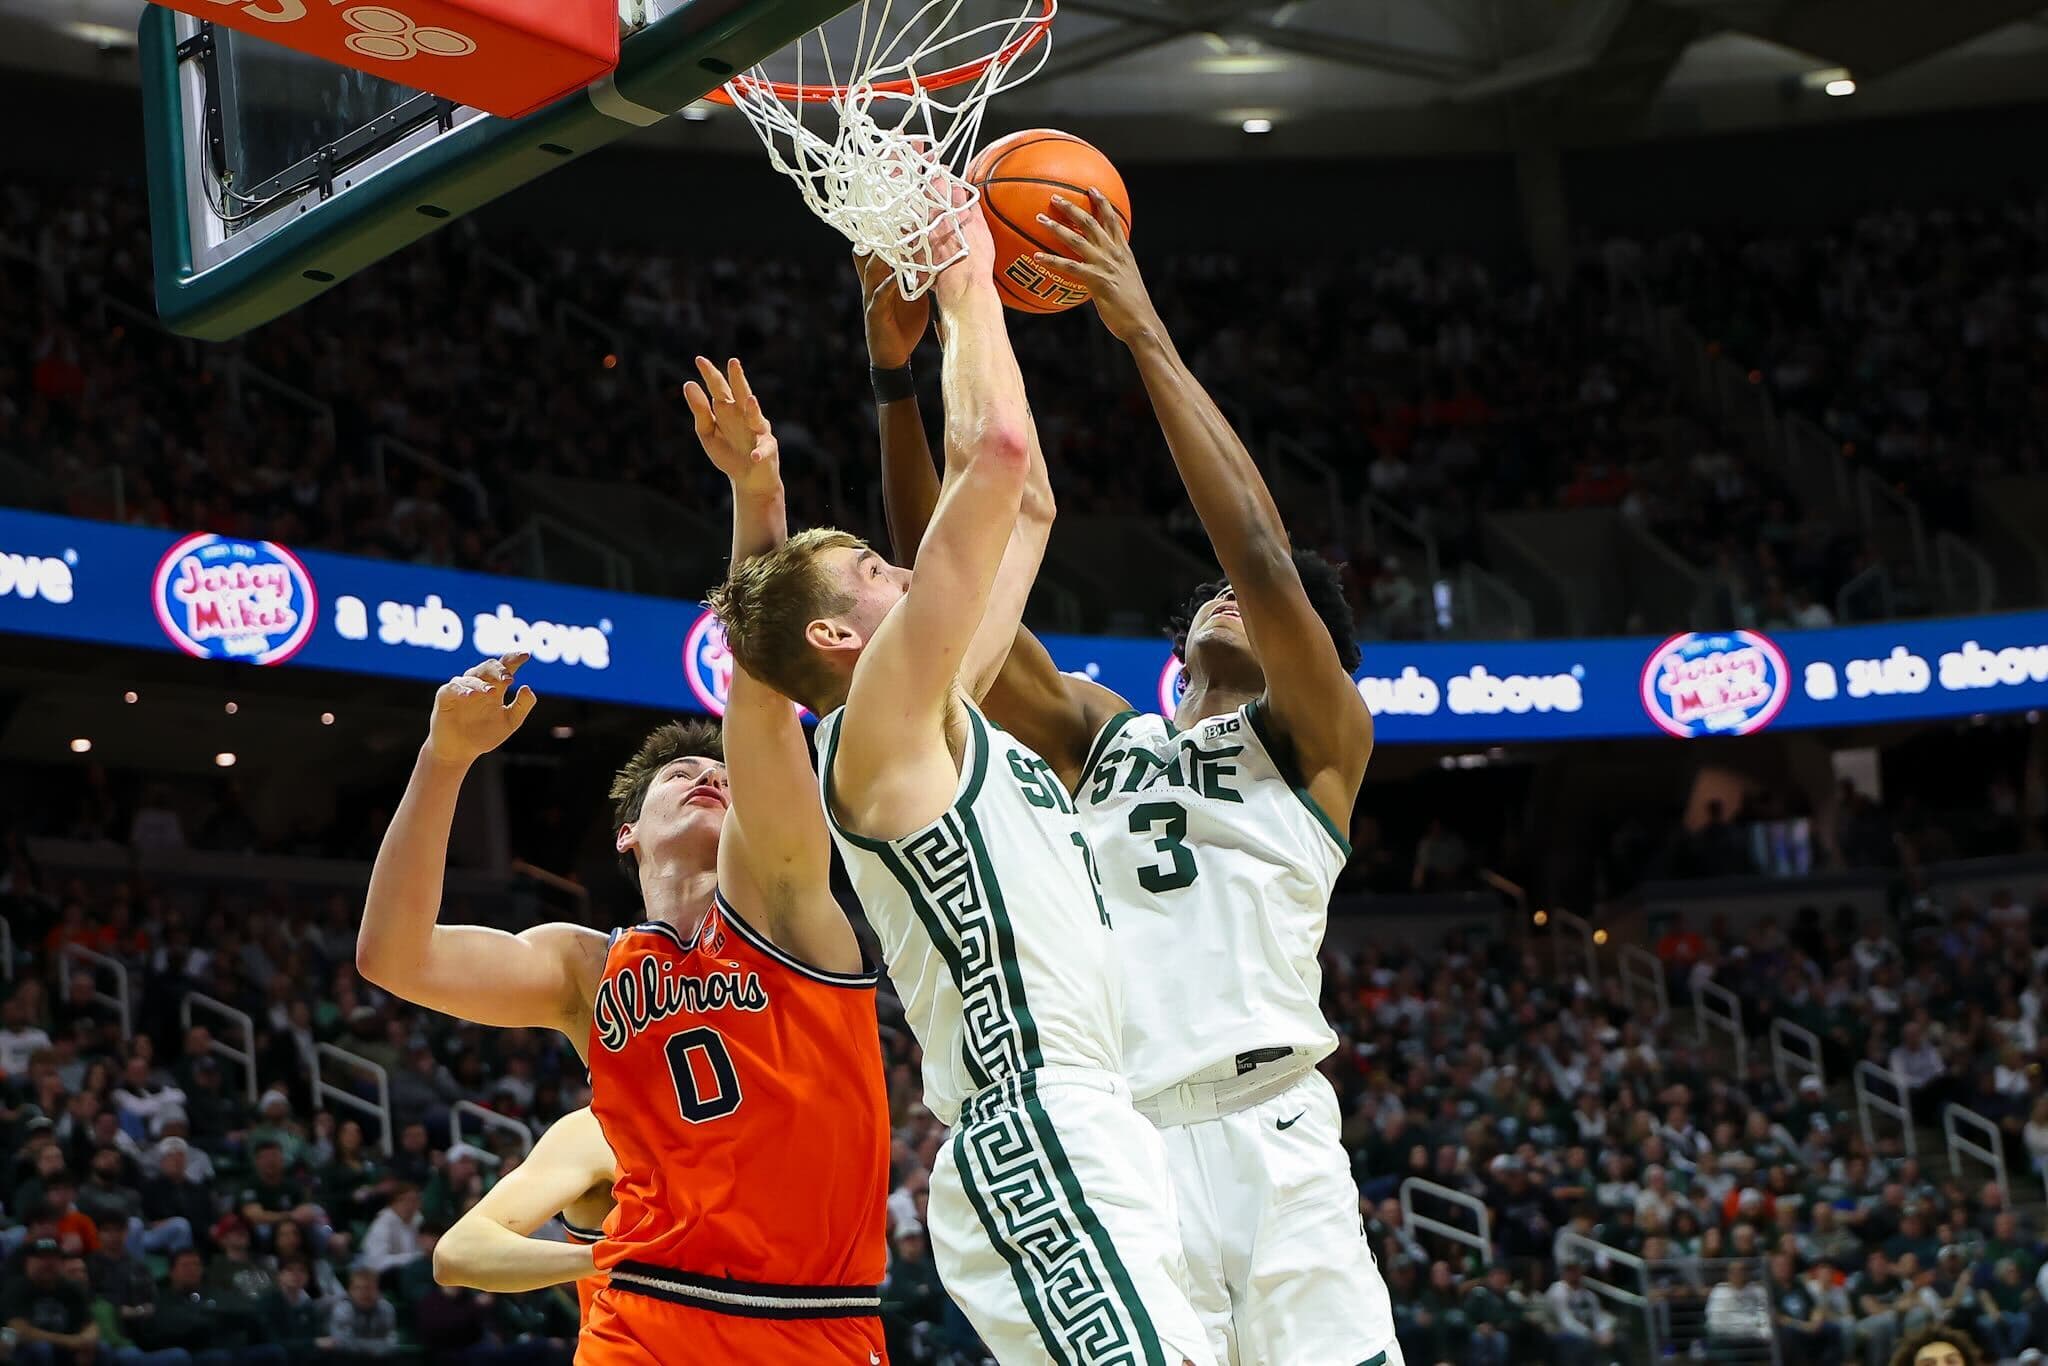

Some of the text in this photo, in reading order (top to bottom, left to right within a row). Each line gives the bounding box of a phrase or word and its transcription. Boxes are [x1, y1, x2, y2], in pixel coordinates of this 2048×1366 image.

[1004, 257, 1088, 306] ELITE
[177, 559, 290, 600] Jersey
[334, 595, 368, 640] a
[377, 594, 464, 652] sub
[1804, 661, 1838, 701] a
[1845, 646, 1931, 698] sub
[1090, 738, 1245, 805] STATE
[1128, 801, 1198, 894] 3
[594, 954, 769, 1053] Illinois
[664, 1026, 743, 1125] 0
